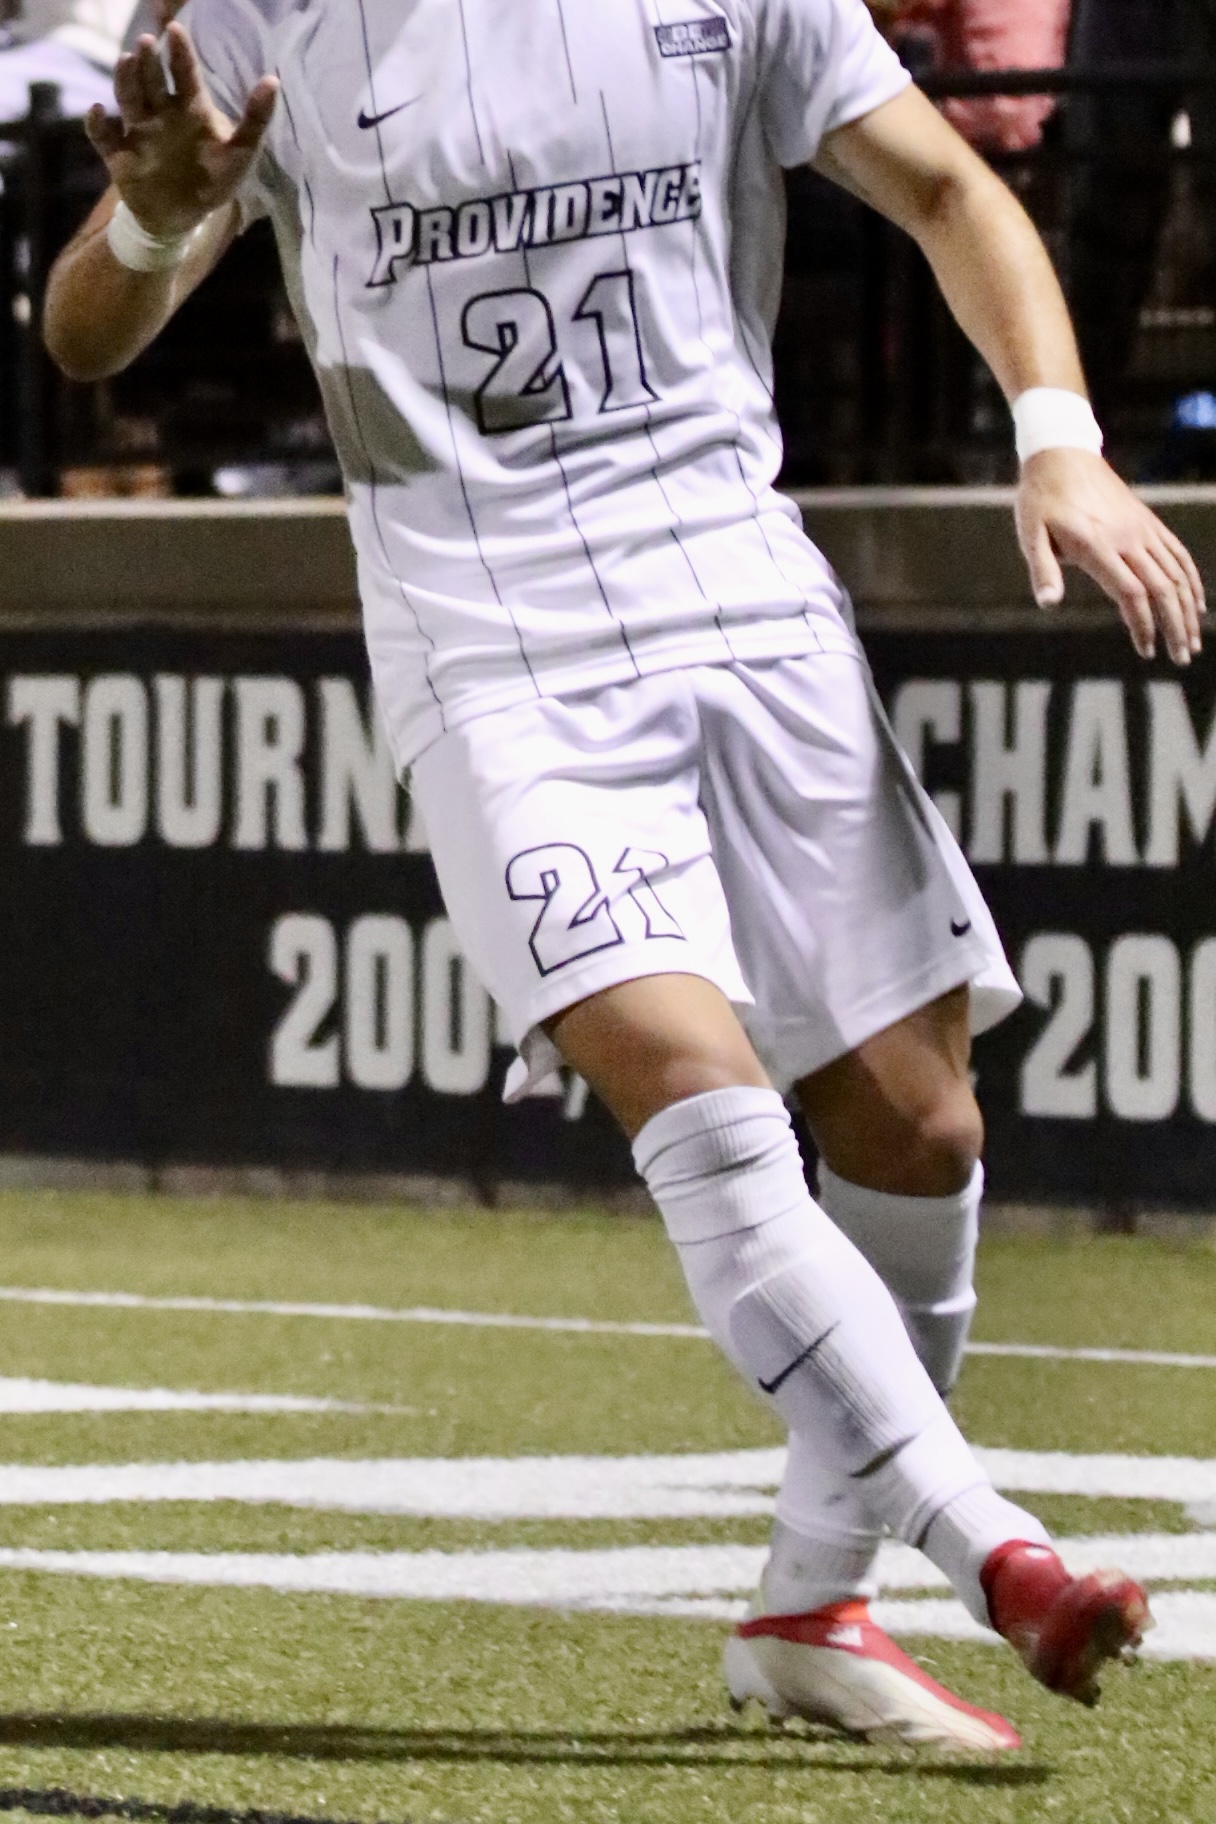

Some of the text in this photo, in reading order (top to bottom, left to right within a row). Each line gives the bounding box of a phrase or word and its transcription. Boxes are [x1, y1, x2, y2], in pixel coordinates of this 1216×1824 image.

[365, 160, 702, 288] PROVIDENCE
[461, 269, 660, 435] 21
[5, 673, 432, 855] TOURN
[505, 842, 687, 977] 21
[268, 911, 590, 1121] 200,
